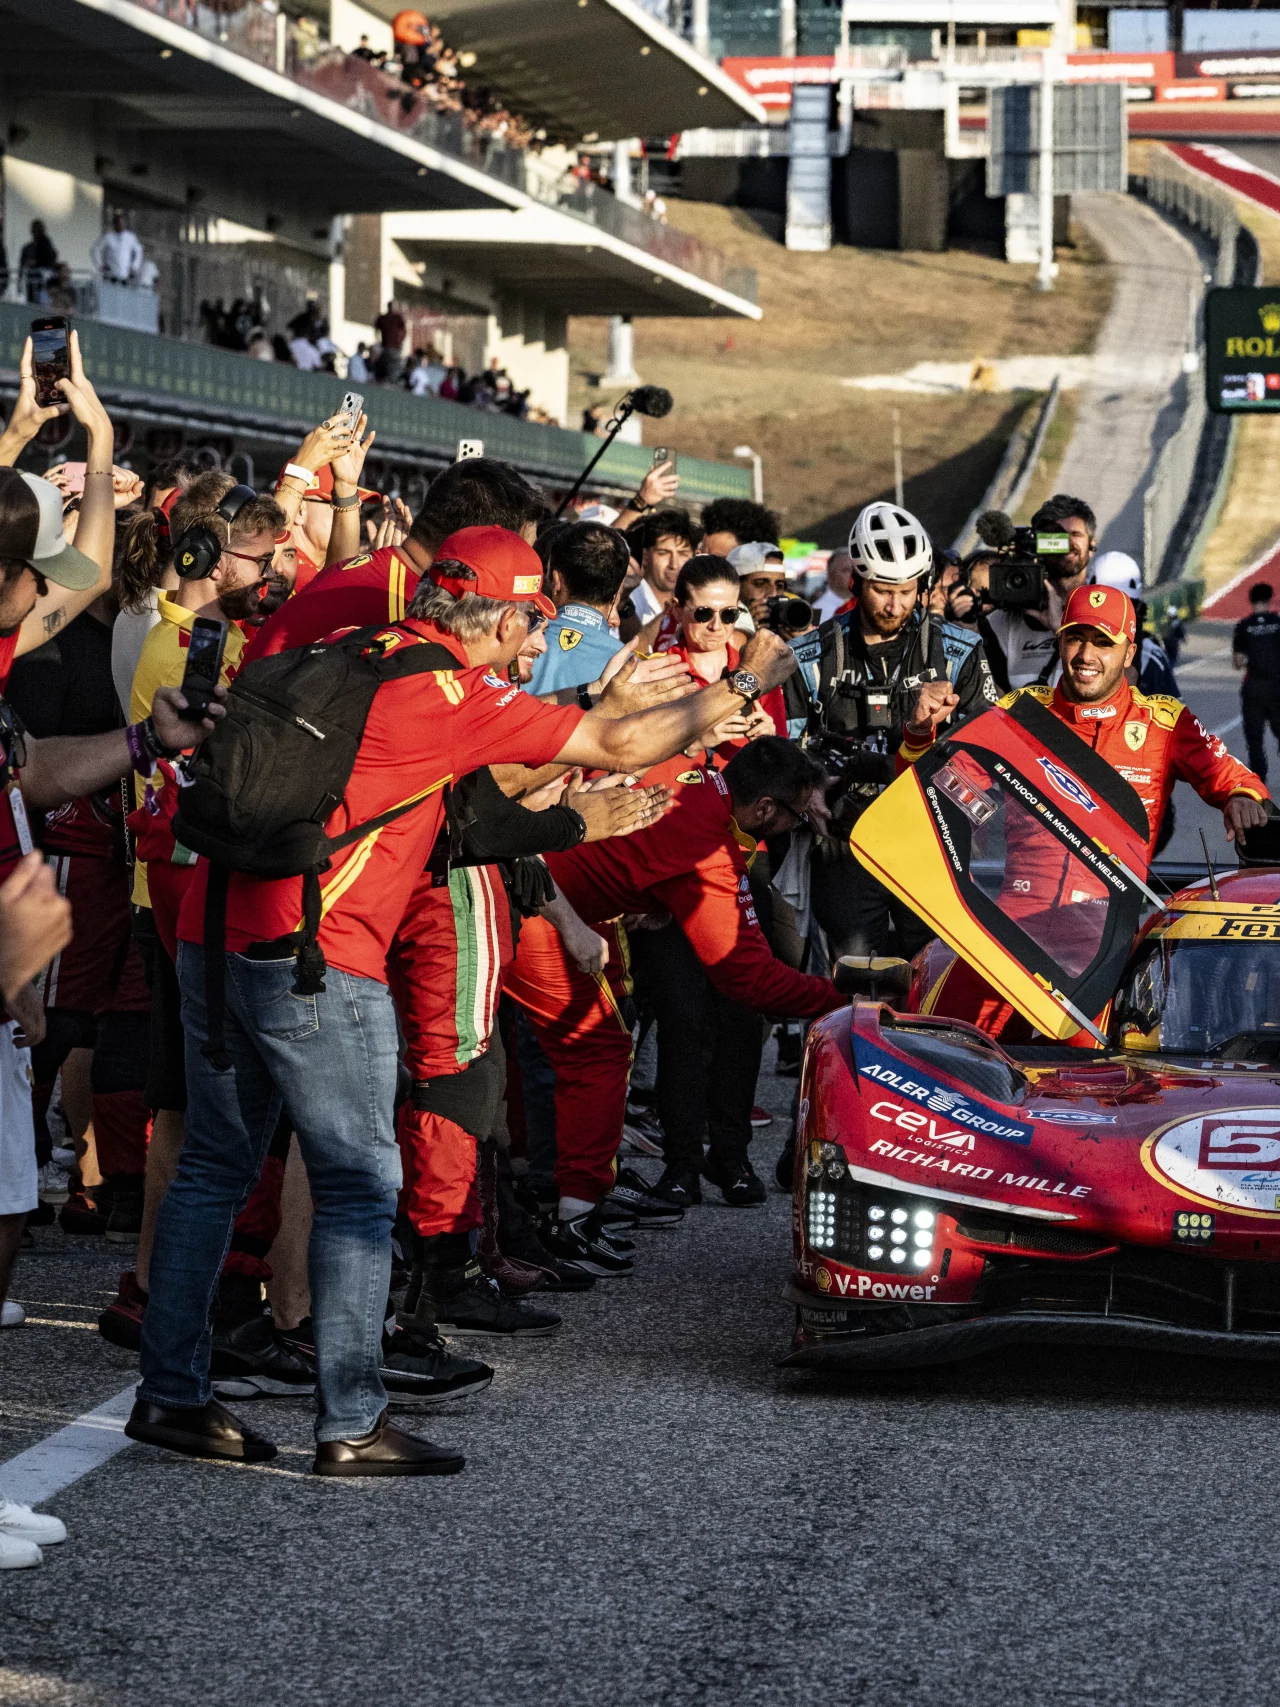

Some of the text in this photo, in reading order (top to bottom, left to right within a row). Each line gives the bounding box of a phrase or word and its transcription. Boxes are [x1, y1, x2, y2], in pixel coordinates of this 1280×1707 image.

[946, 646, 966, 658] OMP
[926, 786, 964, 873] @FerrariHypercar
[1002, 772, 1128, 893] A. FUOCO M. MOLINA N. NIELSEN
[1012, 879, 1031, 893] 50
[859, 1063, 1026, 1139] ADLER GROUP
[907, 1134, 970, 1157] LOGISTICS
[868, 1138, 1093, 1199] RICHARD MILLE
[834, 1273, 938, 1301] V-Power
